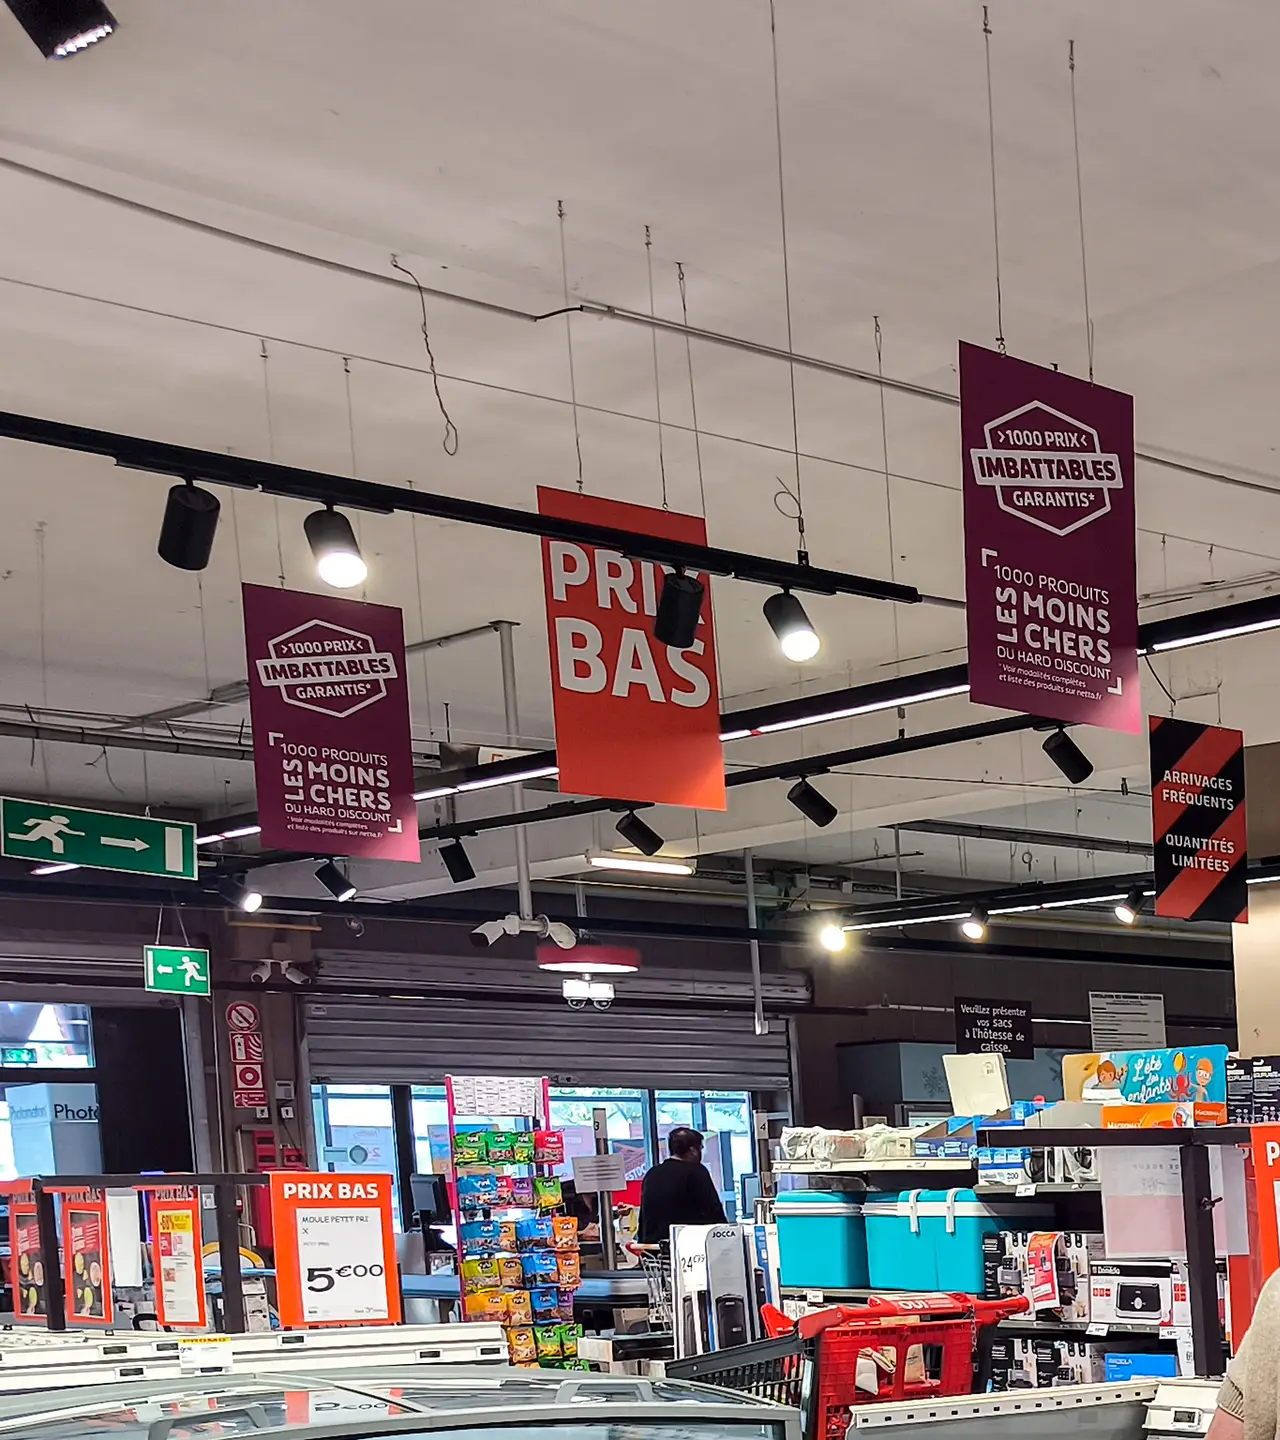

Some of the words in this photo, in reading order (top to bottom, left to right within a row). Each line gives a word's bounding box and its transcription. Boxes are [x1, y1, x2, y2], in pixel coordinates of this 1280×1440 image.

[978, 456, 1116, 482] IMBATTABLES
[549, 541, 705, 624] PRI
[994, 565, 1034, 587] 1000
[1039, 575, 1110, 604] PRODUITS
[996, 586, 1018, 643] LES
[1023, 591, 1111, 634] MOINS
[1024, 622, 1112, 664] CHERS
[263, 657, 391, 681] IMBATTABLES
[555, 617, 711, 709] BAS
[997, 645, 1015, 661] DU
[1018, 651, 1051, 669] HARD
[1055, 658, 1111, 681] DISCOUNT
[280, 743, 318, 758] 1000
[322, 748, 388, 766] PRODUITS
[282, 758, 305, 801] LES
[308, 761, 391, 788] MOINS
[1163, 769, 1233, 792] ARRIVAGES
[309, 784, 392, 811] CHERS
[1162, 788, 1234, 811] FRÉQUENTS
[285, 803, 302, 814] DU
[304, 805, 335, 817] HARD
[338, 808, 392, 823] DISCOUNT
[1165, 833, 1234, 855] QUANTITÉS
[1171, 852, 1230, 873] LIMITÉES
[960, 1004, 990, 1015] Veuillez
[992, 1005, 1026, 1017] présenter
[977, 1019, 990, 1027] vos
[993, 1018, 1012, 1028] sacs
[1015, 1032, 1025, 1041] de
[283, 1183, 334, 1199] PRIX
[338, 1183, 379, 1199] BAS
[307, 1264, 383, 1292] 5€00
